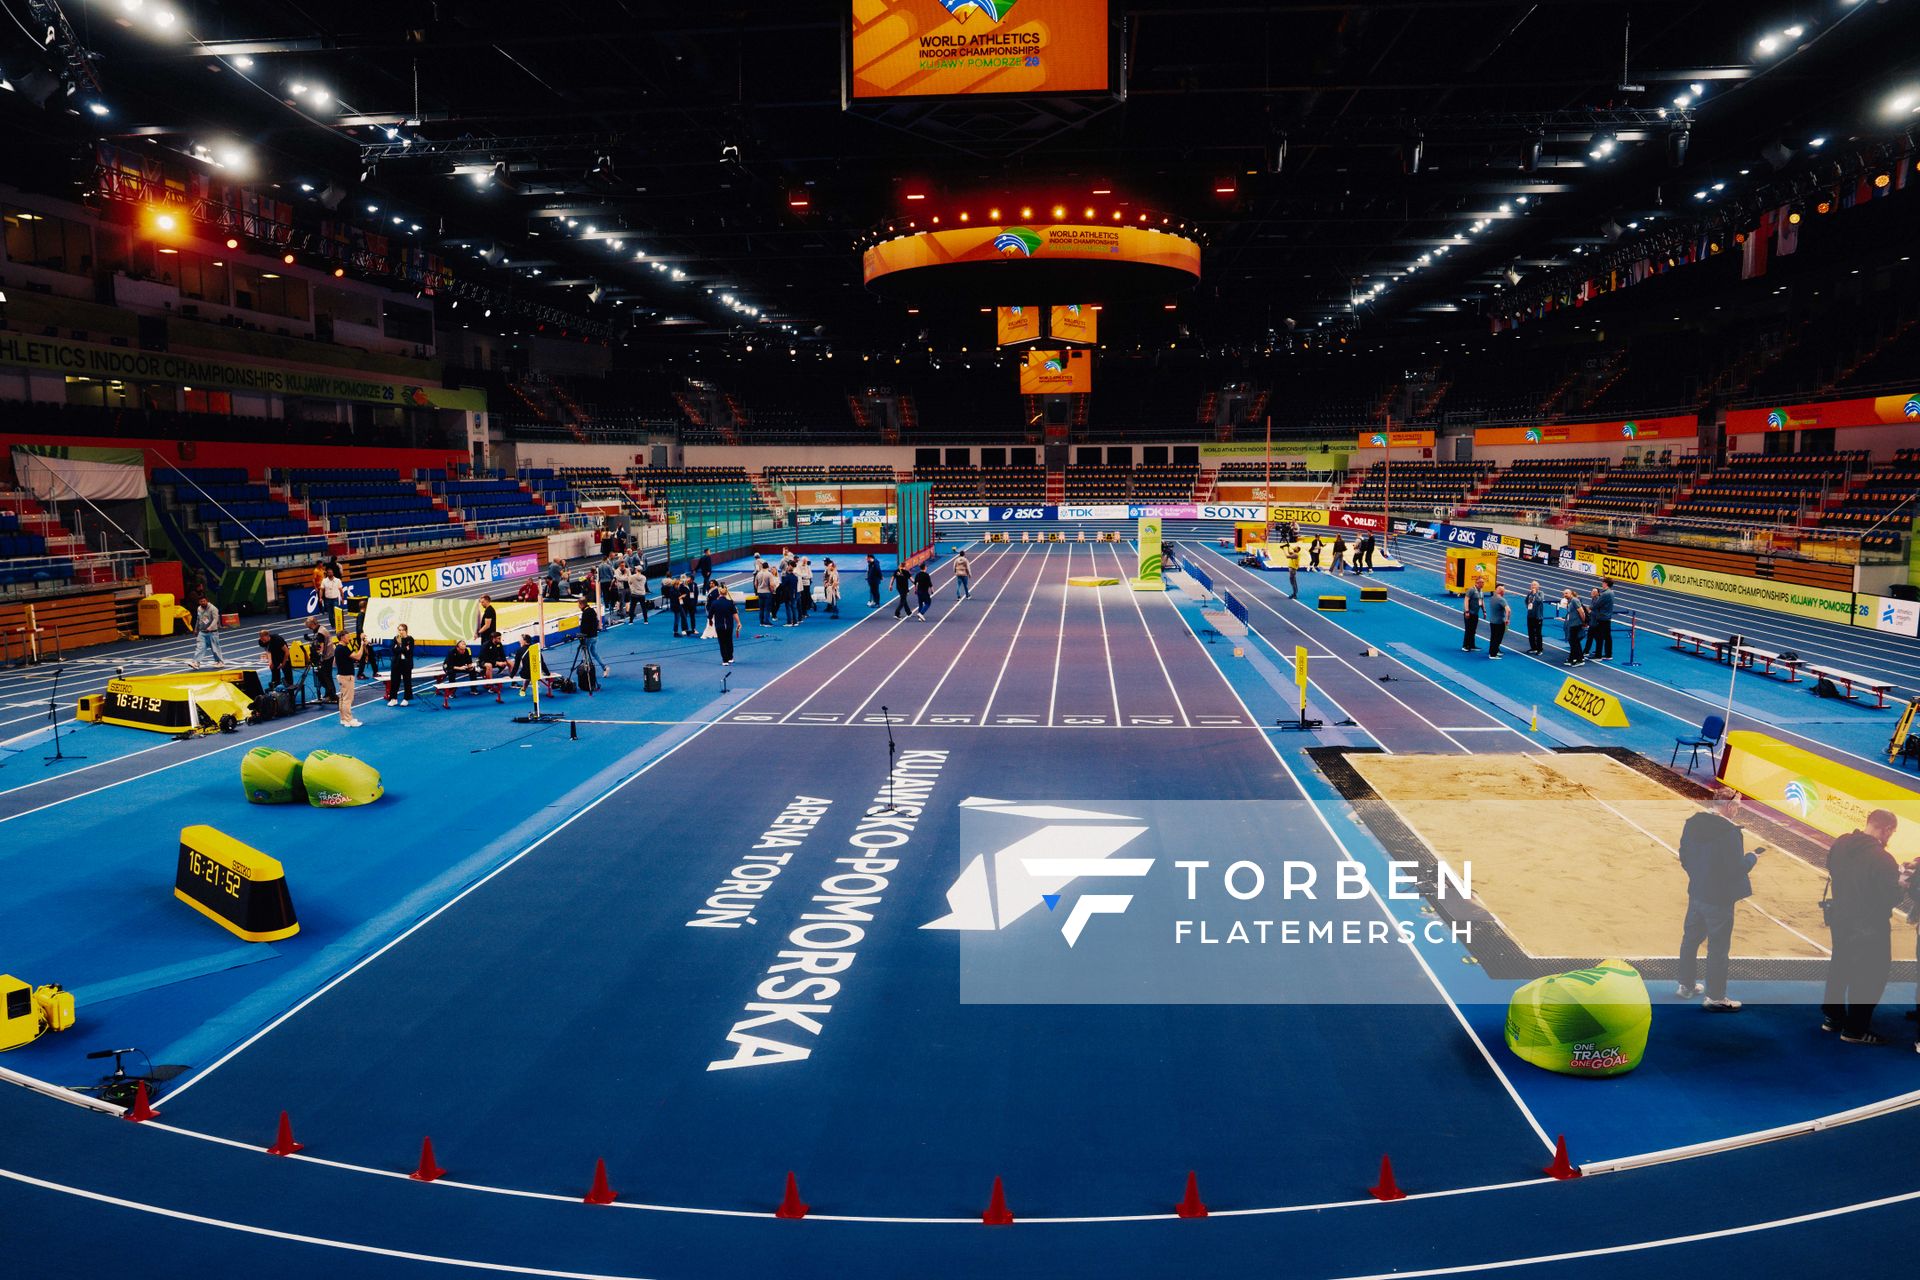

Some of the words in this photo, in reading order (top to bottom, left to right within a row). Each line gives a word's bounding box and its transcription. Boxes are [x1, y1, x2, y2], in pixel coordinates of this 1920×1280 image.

[920, 35, 966, 48] WORLD
[970, 32, 1040, 46] ATHLETICS
[920, 49, 957, 58] INDOOR
[960, 45, 1040, 57] CHAMPIONSHIPS
[920, 60, 963, 69] KUJAWY
[968, 57, 1022, 67] POMORZE
[1025, 56, 1040, 67] 26
[1049, 230, 1078, 238] WORLD
[1080, 231, 1119, 240] ATHLETICS
[1073, 238, 1119, 246] CHAMPIONSHIPS
[90, 350, 160, 376] INDOOR
[164, 359, 283, 389] CHAMPIONSHIPS
[286, 374, 330, 393] KUJAWY
[333, 380, 380, 399] POMORZE
[382, 386, 394, 400] 26
[930, 509, 982, 520] SONY
[1014, 508, 1044, 519] asics
[1069, 509, 1093, 517] TDK
[1138, 508, 1163, 516] TDK
[1205, 507, 1260, 518] SONY
[1274, 509, 1321, 522] SEIKO
[1457, 529, 1476, 544] asics
[442, 563, 487, 587] SONY
[498, 561, 515, 575] TDK
[1602, 557, 1639, 580] SEIKO
[379, 573, 429, 598] SEIKO
[1669, 574, 1687, 584] WORLD
[1687, 577, 1714, 589] ATHLETICS
[1715, 581, 1737, 593] INDOOR
[1738, 585, 1789, 603] CHAMPIONSHIPS
[1790, 594, 1818, 608] KUJAWY
[1859, 605, 1869, 616] 26
[110, 683, 132, 693] SEIKO
[116, 694, 162, 712] 16:21:52
[1563, 684, 1606, 717] SEIKO
[330, 796, 352, 805] GOAL
[751, 795, 833, 849] ARENA
[189, 850, 240, 898] 16:21:52
[231, 860, 251, 878] SEIKO
[685, 853, 794, 929] TORUŃ
[706, 750, 950, 1072] KUJAWSKO-POMORSKA
[1573, 1043, 1595, 1051] ONE
[1573, 1047, 1619, 1060] TRACK
[1591, 1054, 1628, 1069] GOAL
